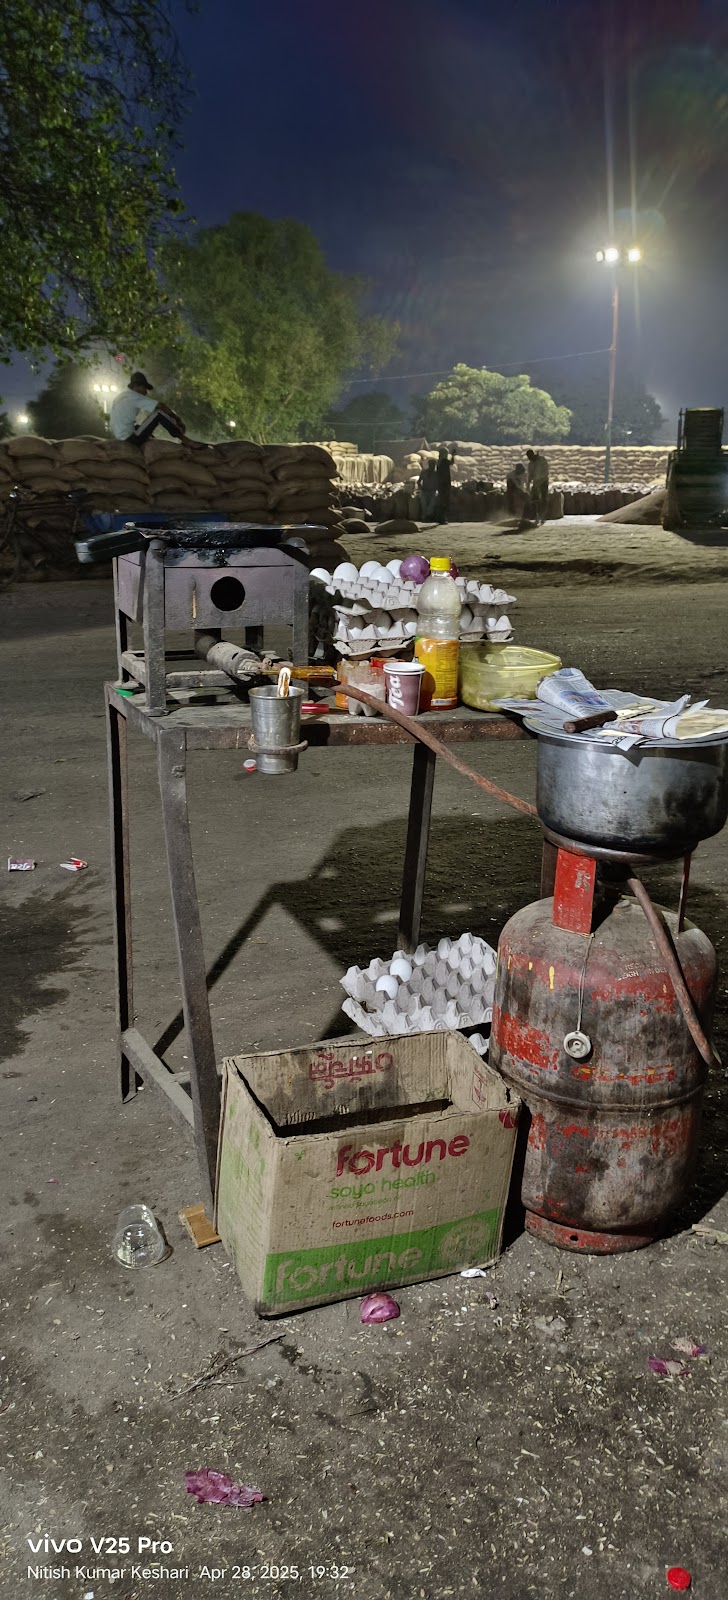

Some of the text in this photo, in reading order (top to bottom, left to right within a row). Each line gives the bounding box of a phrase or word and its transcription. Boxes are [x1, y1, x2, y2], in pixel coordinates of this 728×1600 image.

[388, 675, 405, 709] Tea
[336, 1135, 471, 1177] fortune
[328, 1170, 437, 1200] soya health
[332, 1209, 415, 1229] fortunefoods.com
[275, 1246, 424, 1293] fortune
